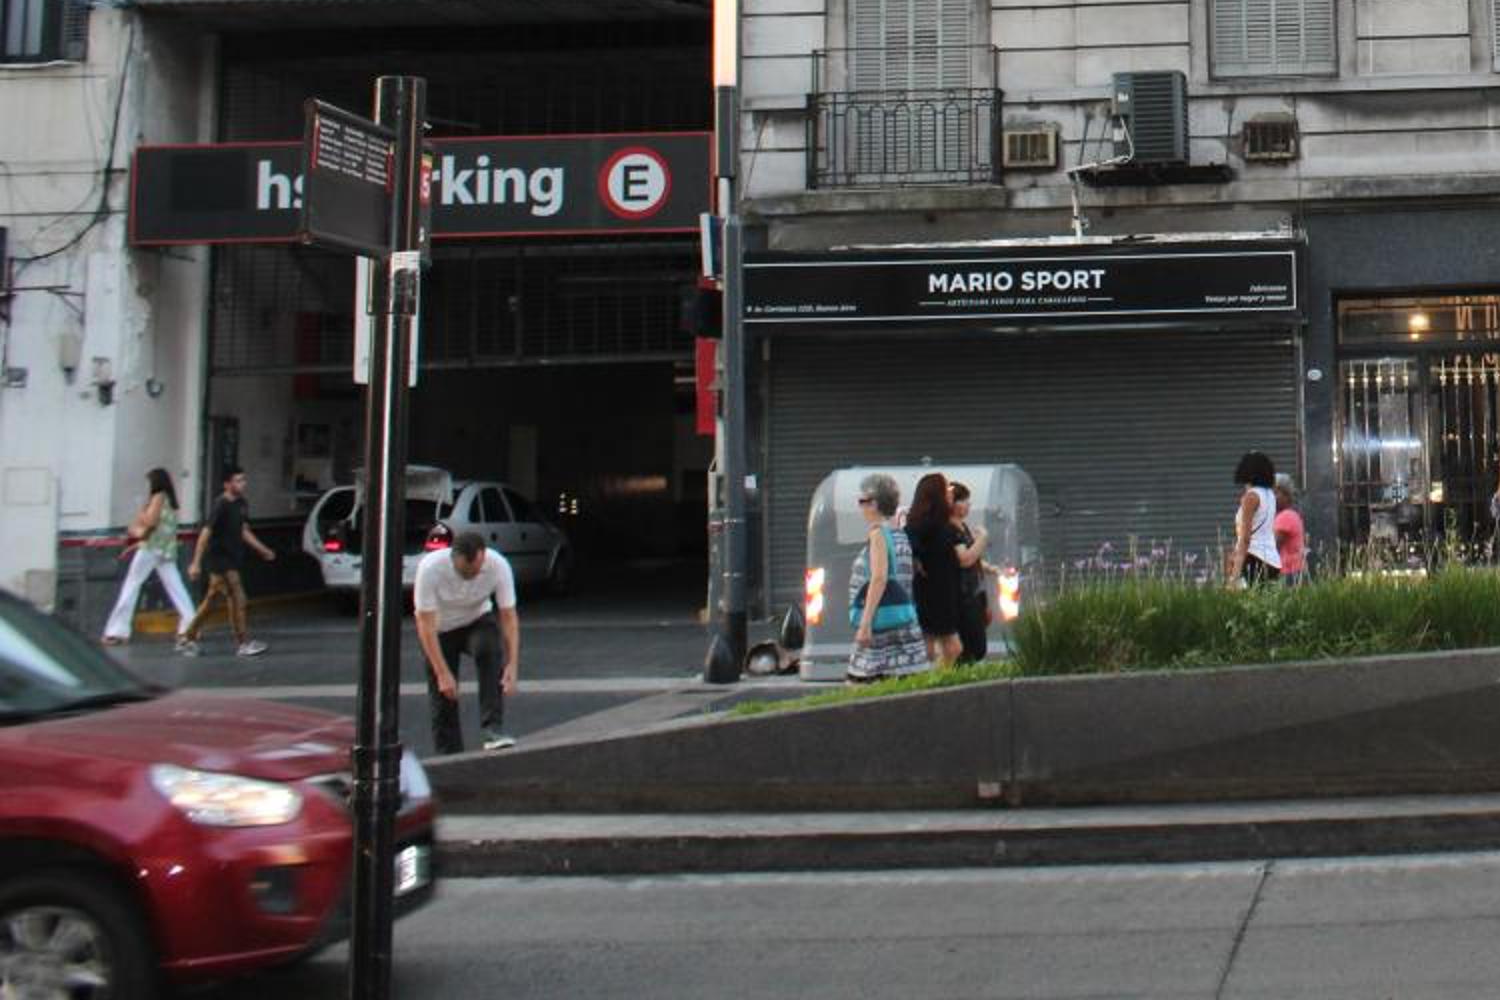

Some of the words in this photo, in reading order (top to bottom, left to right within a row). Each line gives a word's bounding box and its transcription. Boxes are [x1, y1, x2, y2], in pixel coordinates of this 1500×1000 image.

[624, 164, 650, 201] E
[929, 272, 1013, 292] MARIO
[1021, 270, 1105, 291] SPORT
